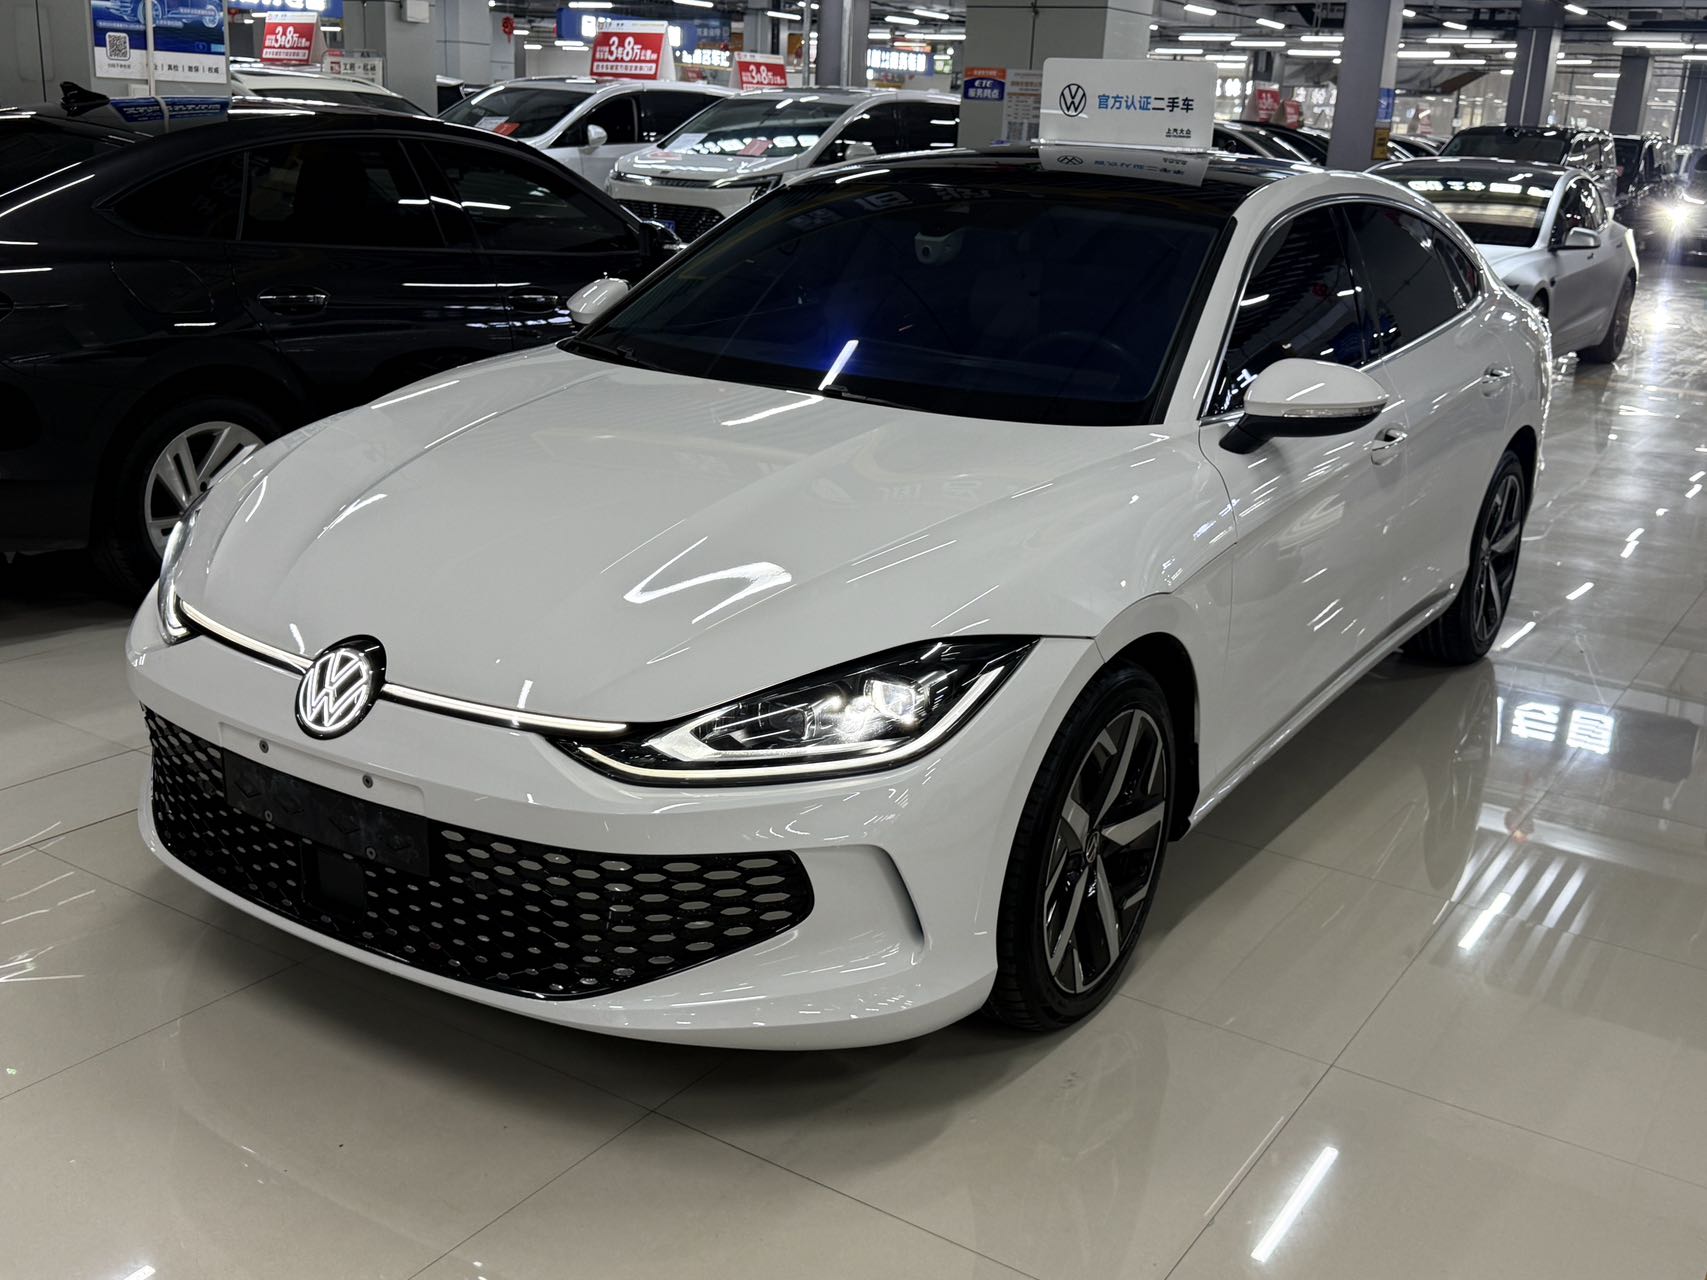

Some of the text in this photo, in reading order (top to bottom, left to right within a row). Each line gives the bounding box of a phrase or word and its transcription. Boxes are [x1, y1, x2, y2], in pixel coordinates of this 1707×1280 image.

[974, 79, 994, 88] ETC
[1097, 94, 1195, 113] 官方认证二手车
[1165, 127, 1192, 135] 上汽大众
